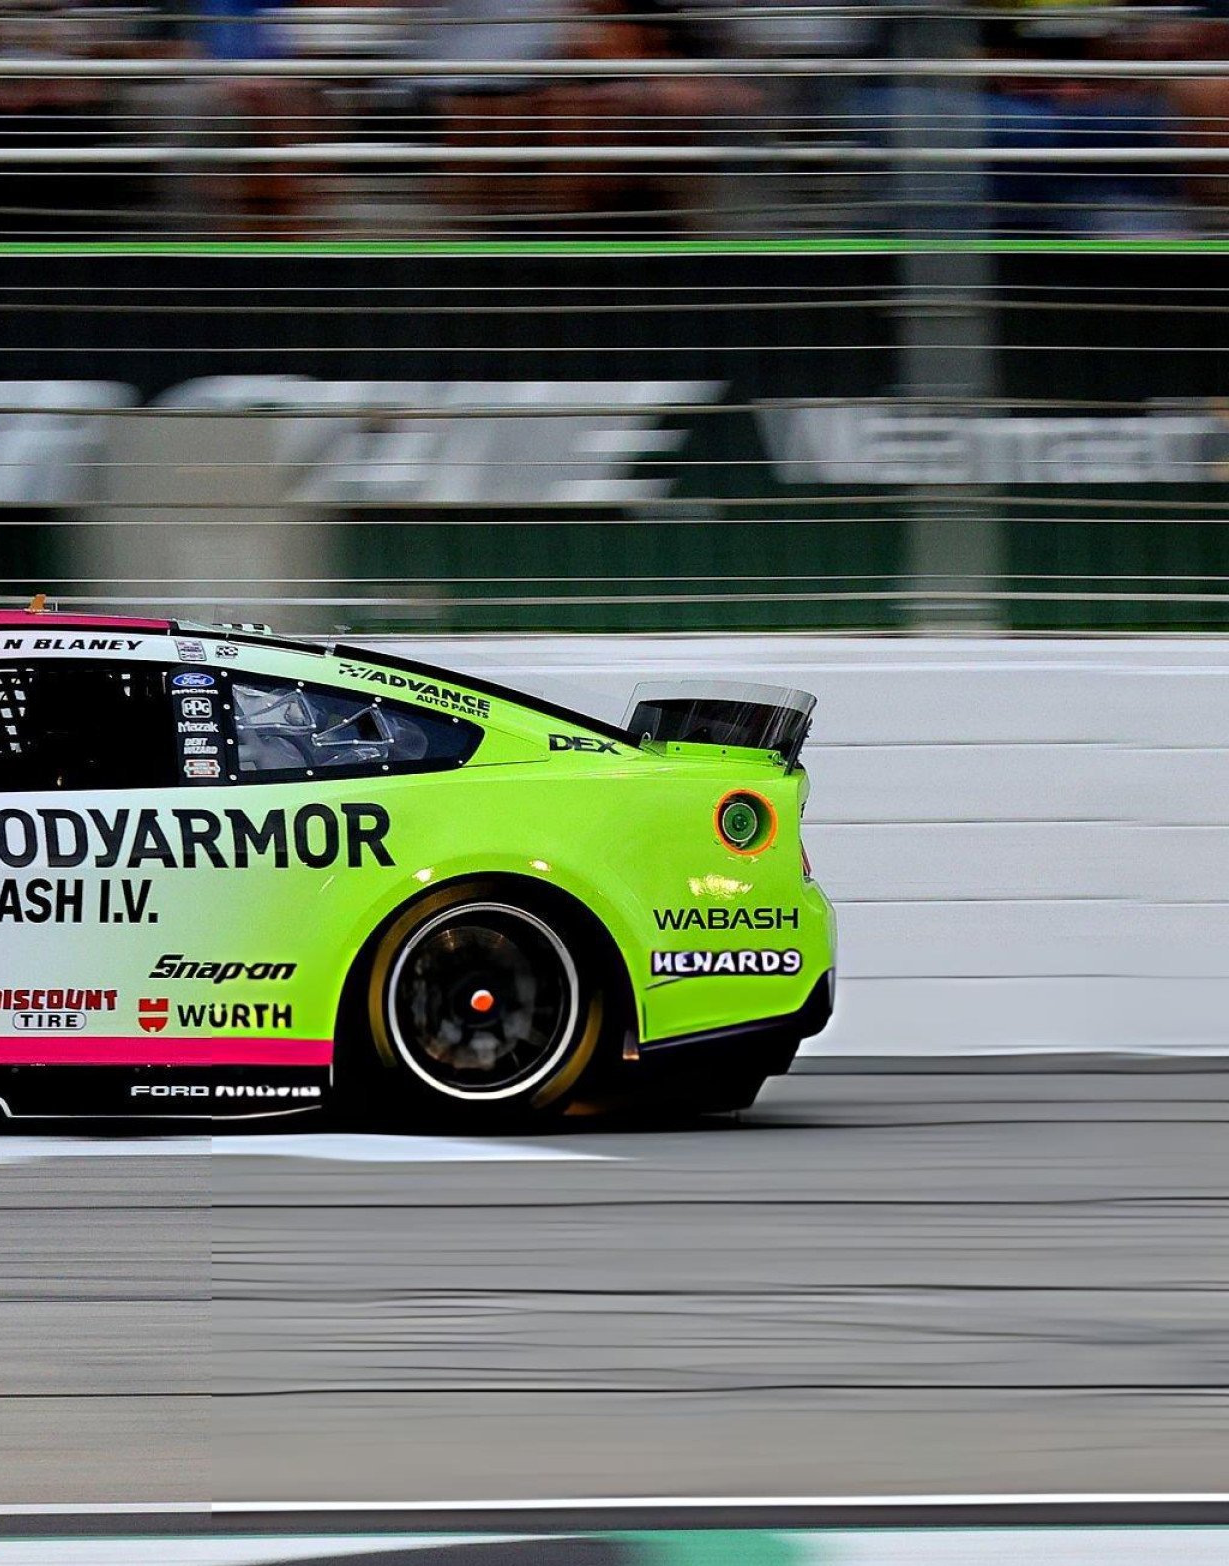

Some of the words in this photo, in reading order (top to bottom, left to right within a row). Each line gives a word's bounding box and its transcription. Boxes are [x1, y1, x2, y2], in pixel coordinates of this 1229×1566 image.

[33, 639, 143, 651] BLANEY
[368, 671, 490, 712] ADVANCE
[183, 700, 210, 715] PPG
[416, 694, 449, 707] AUTO
[450, 701, 489, 719] PARTS
[177, 721, 219, 733] Mazak
[548, 733, 622, 755] DEX
[99, 879, 159, 923] I.V.
[653, 908, 798, 931] WABASH
[20, 1015, 78, 1028] TIRE
[177, 1003, 293, 1029] WÜRTH
[130, 1085, 210, 1097] FORD
